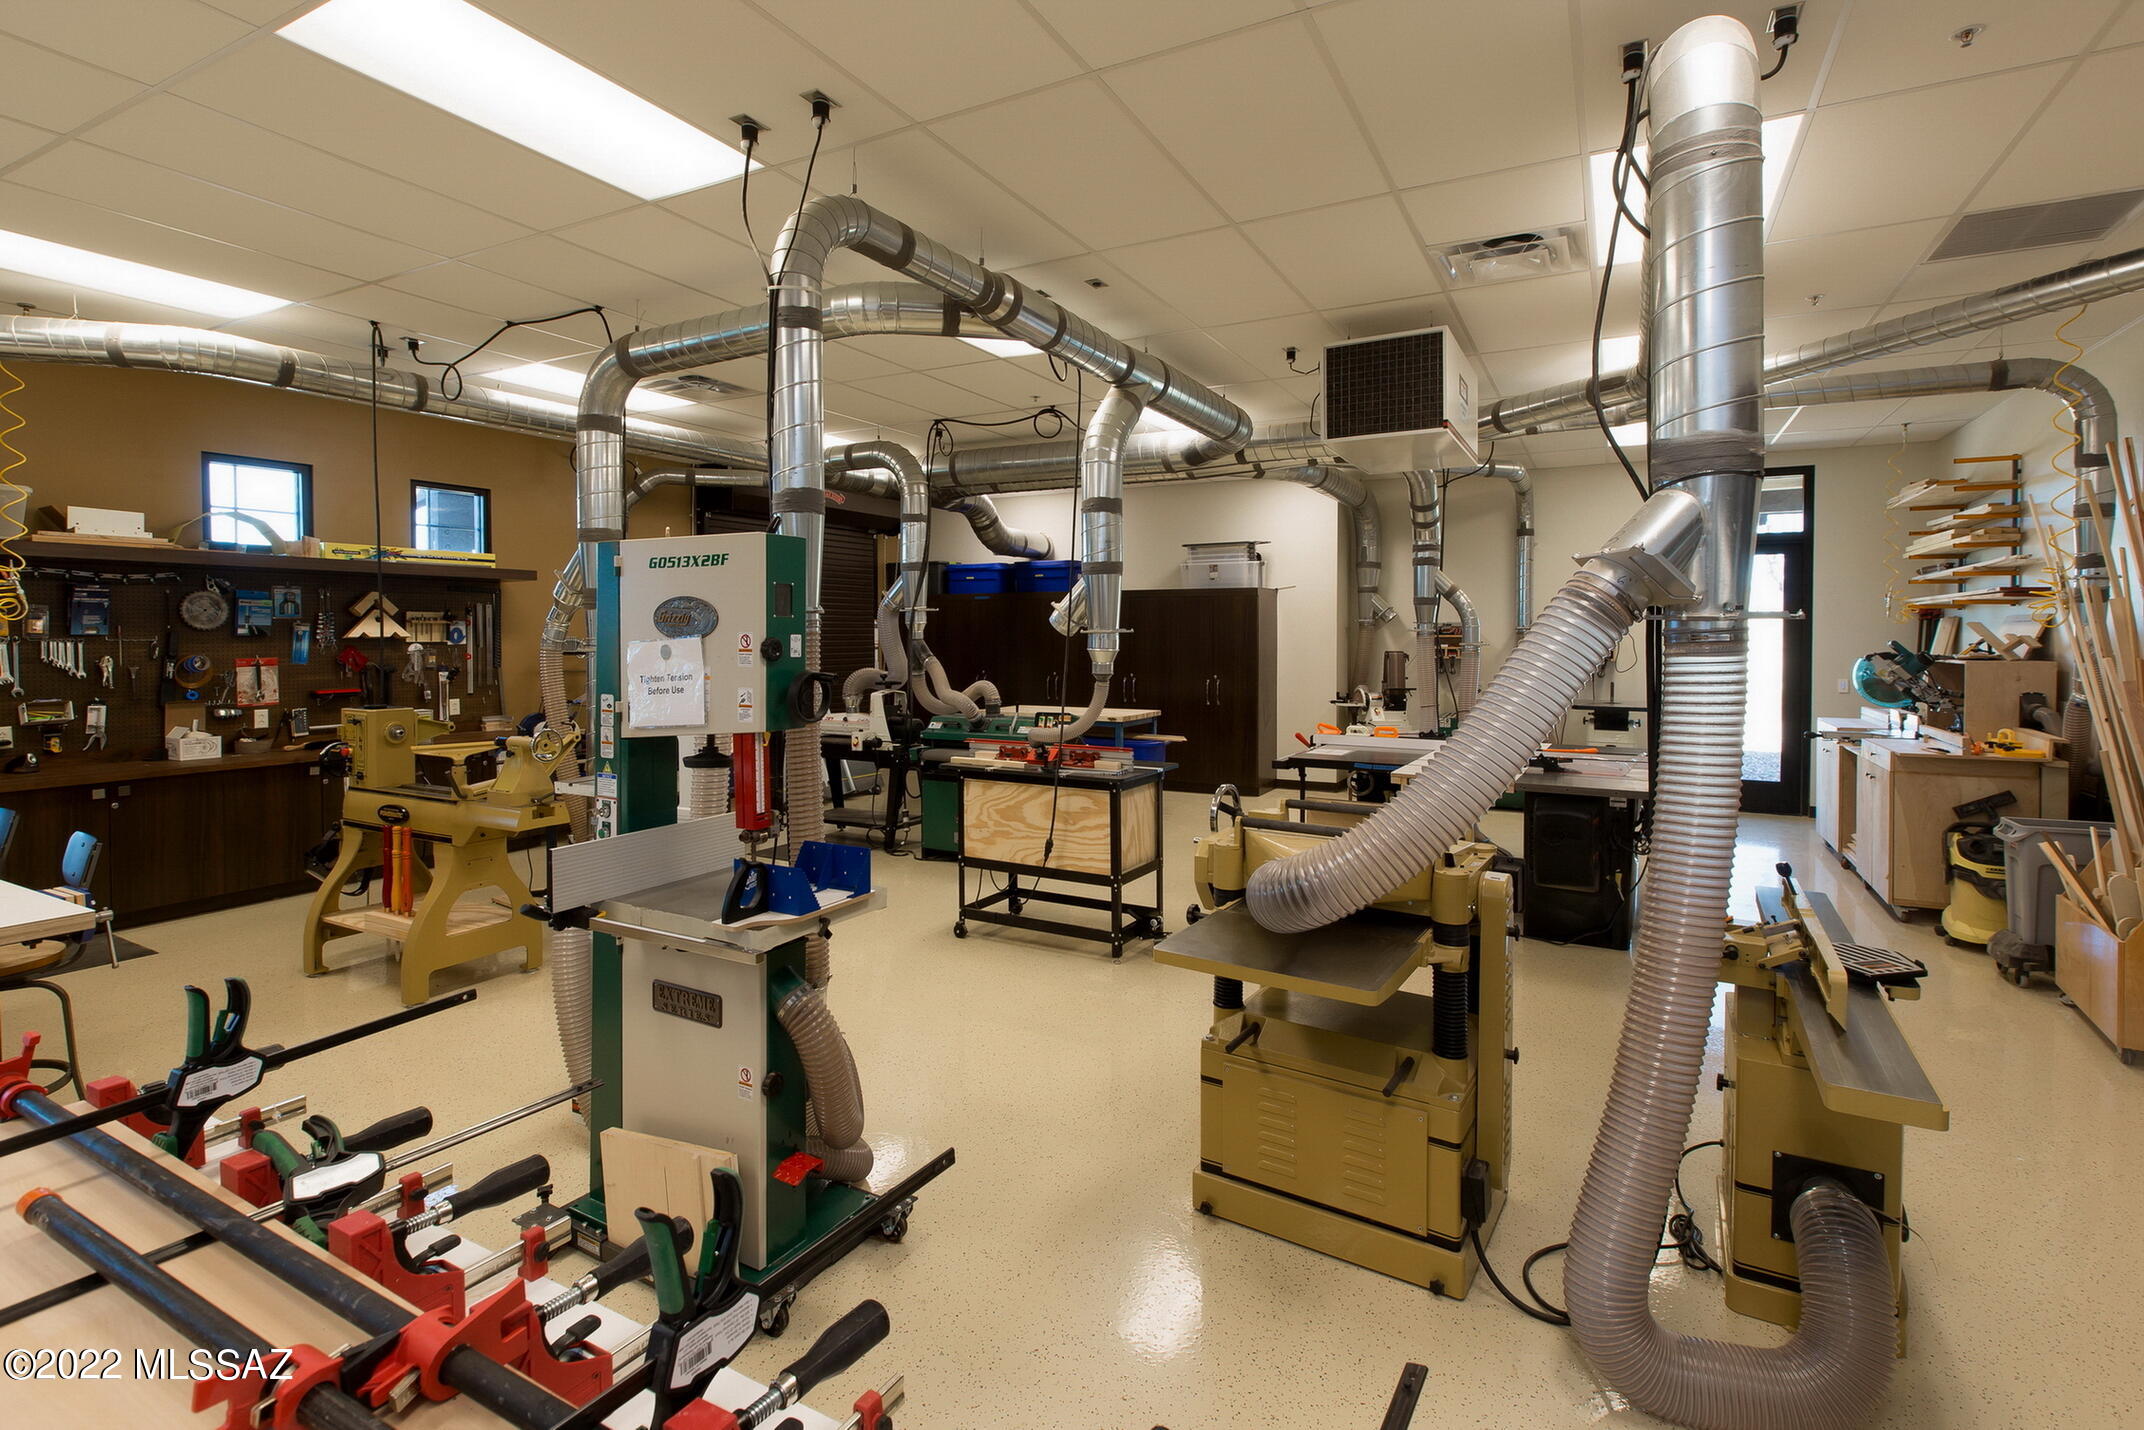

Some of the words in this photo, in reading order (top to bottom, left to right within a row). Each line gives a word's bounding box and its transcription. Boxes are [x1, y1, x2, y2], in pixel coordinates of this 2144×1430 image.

[648, 552, 730, 569] G0513X2BF
[640, 674, 665, 685] Tighten
[667, 673, 693, 682] Tension
[648, 686, 670, 695] Before
[671, 685, 685, 694] Use
[656, 984, 717, 1013] EXTREME
[660, 1001, 711, 1023] SERIES
